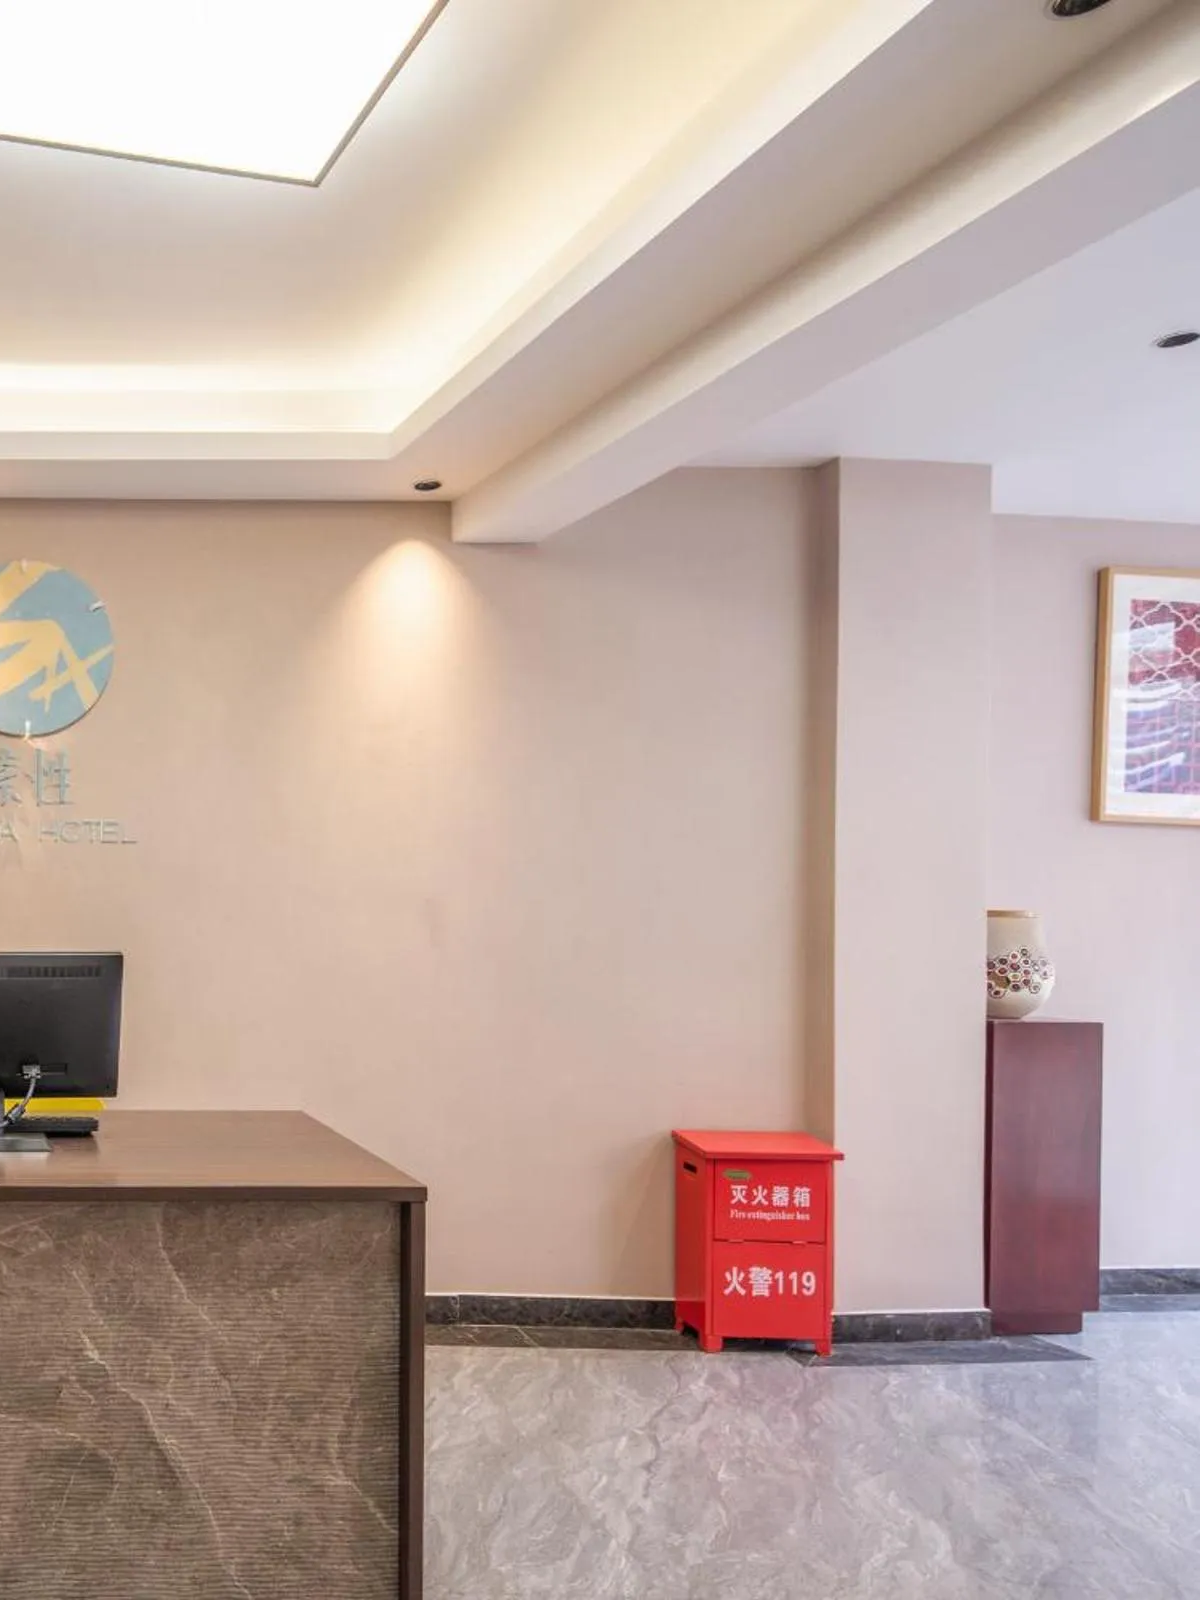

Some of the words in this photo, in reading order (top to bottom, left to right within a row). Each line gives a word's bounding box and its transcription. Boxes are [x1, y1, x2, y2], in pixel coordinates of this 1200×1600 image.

[39, 820, 138, 844] HOTEL
[730, 1185, 811, 1207] 灭火器箱
[730, 1209, 746, 1218] Fire
[796, 1211, 810, 1220] box
[723, 1267, 816, 1297] 火警119
